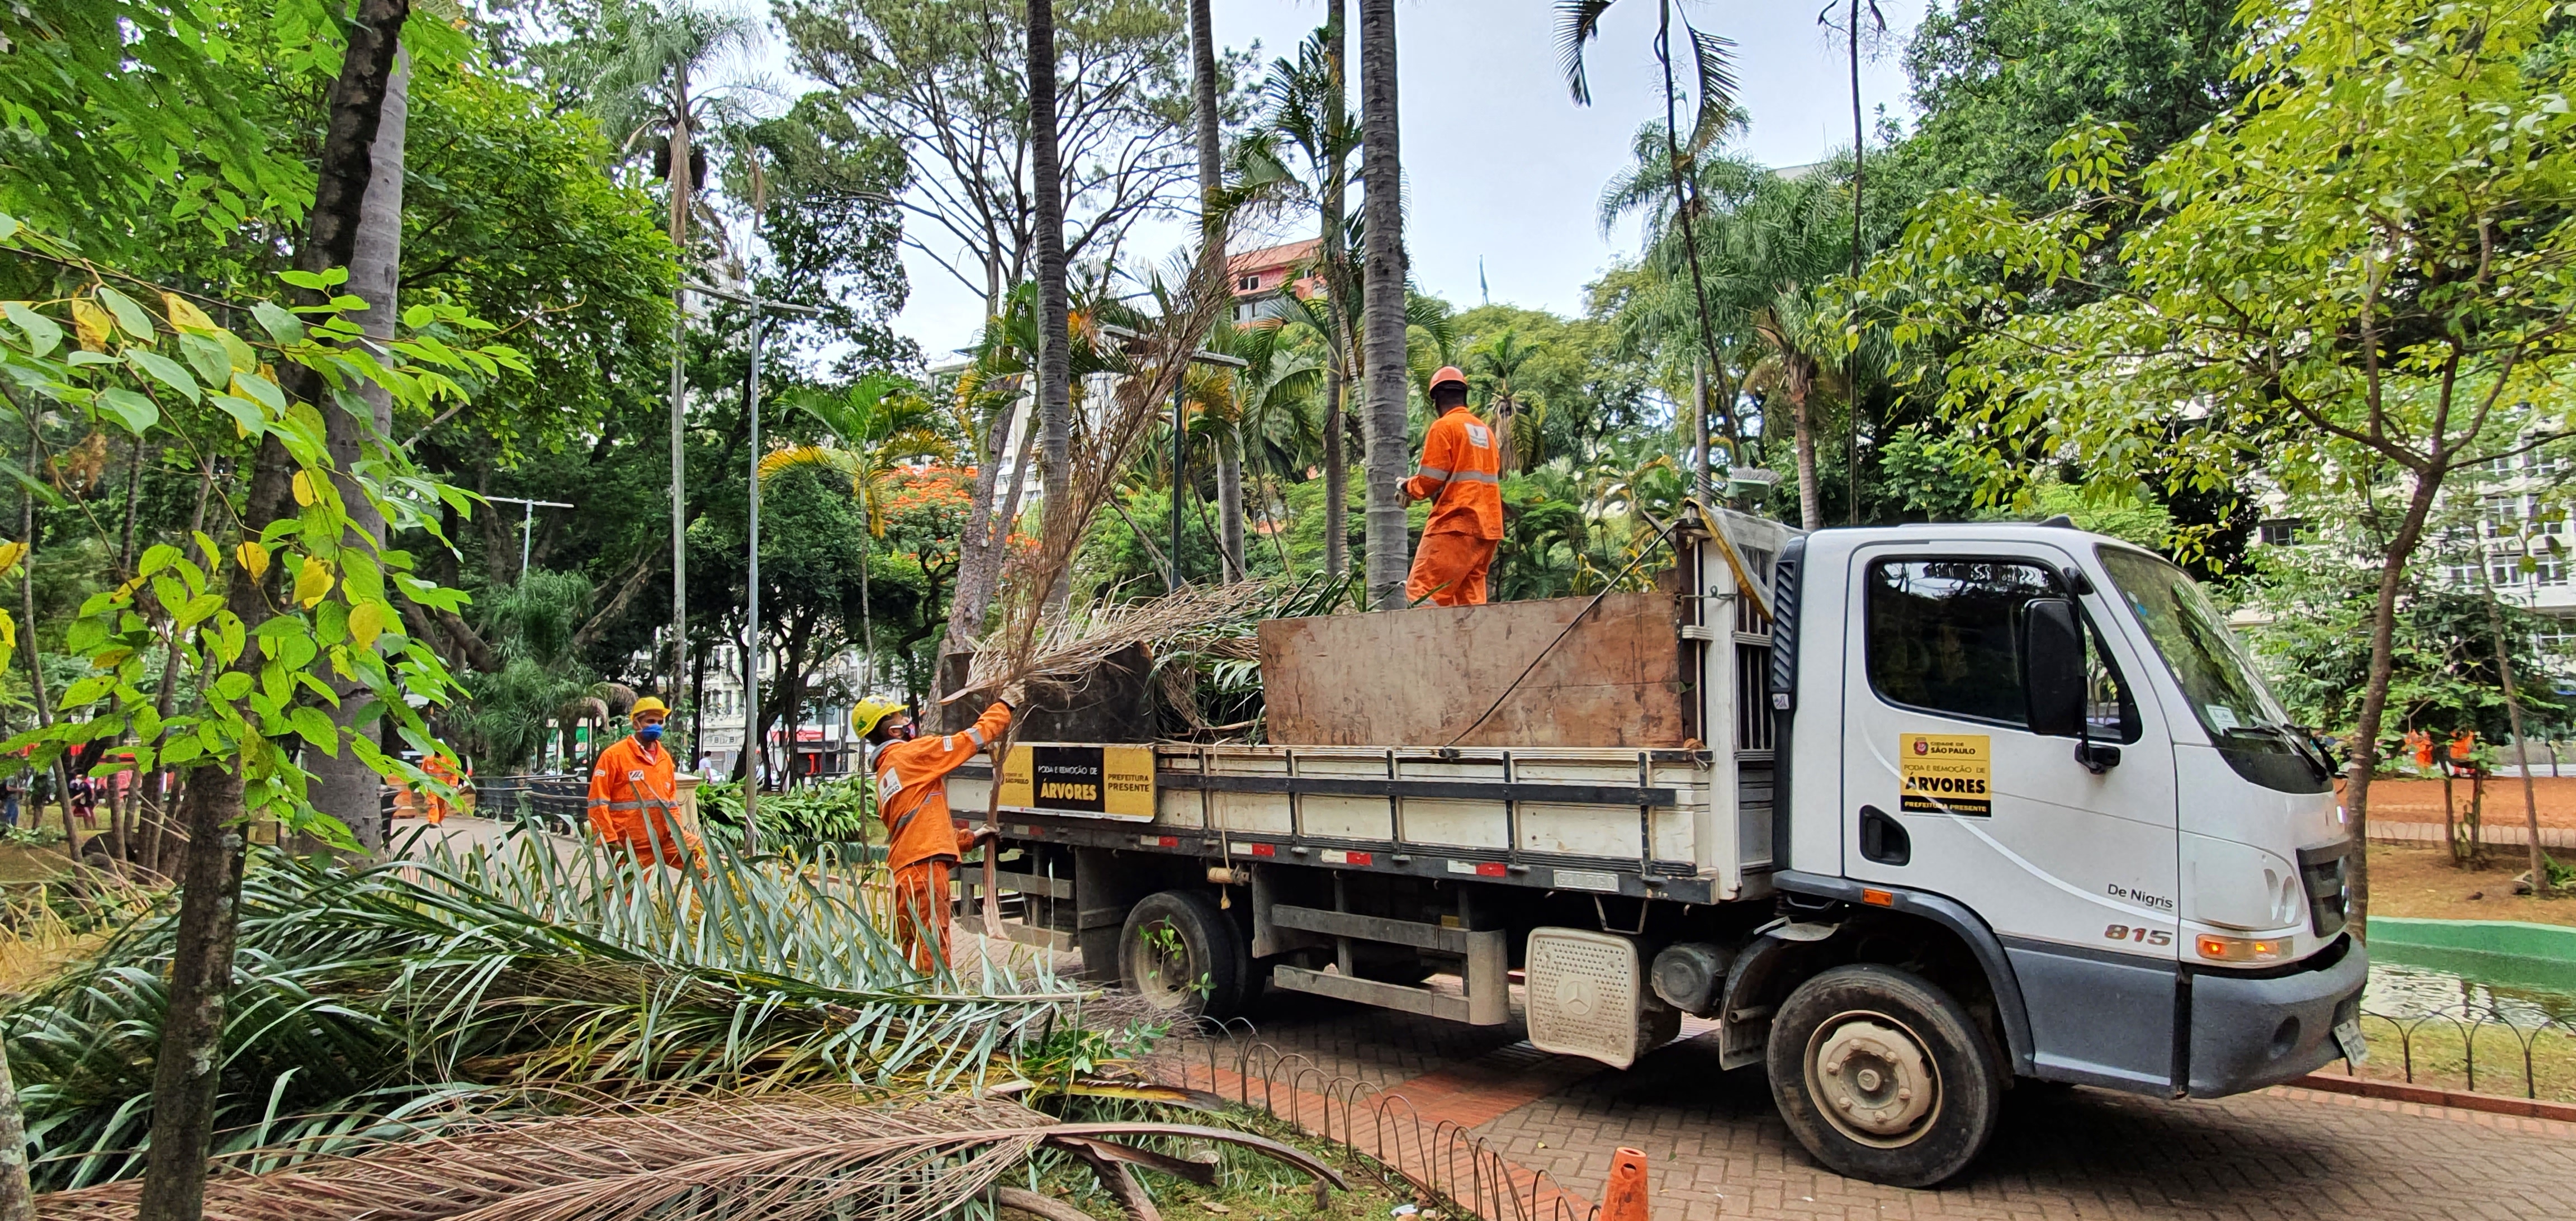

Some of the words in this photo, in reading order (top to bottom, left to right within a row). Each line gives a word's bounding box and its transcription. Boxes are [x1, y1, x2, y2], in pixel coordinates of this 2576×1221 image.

[1933, 765, 1972, 773] REMOÇÃO
[1040, 778, 1097, 801] ÁRVORES
[1108, 783, 1149, 792] PRESENTE
[1905, 772, 1986, 794] ÁRVORES
[1950, 804, 1987, 812] PRESENTE
[2108, 883, 2127, 897] De
[2130, 888, 2173, 908] Nigris
[2104, 924, 2173, 946] 815
